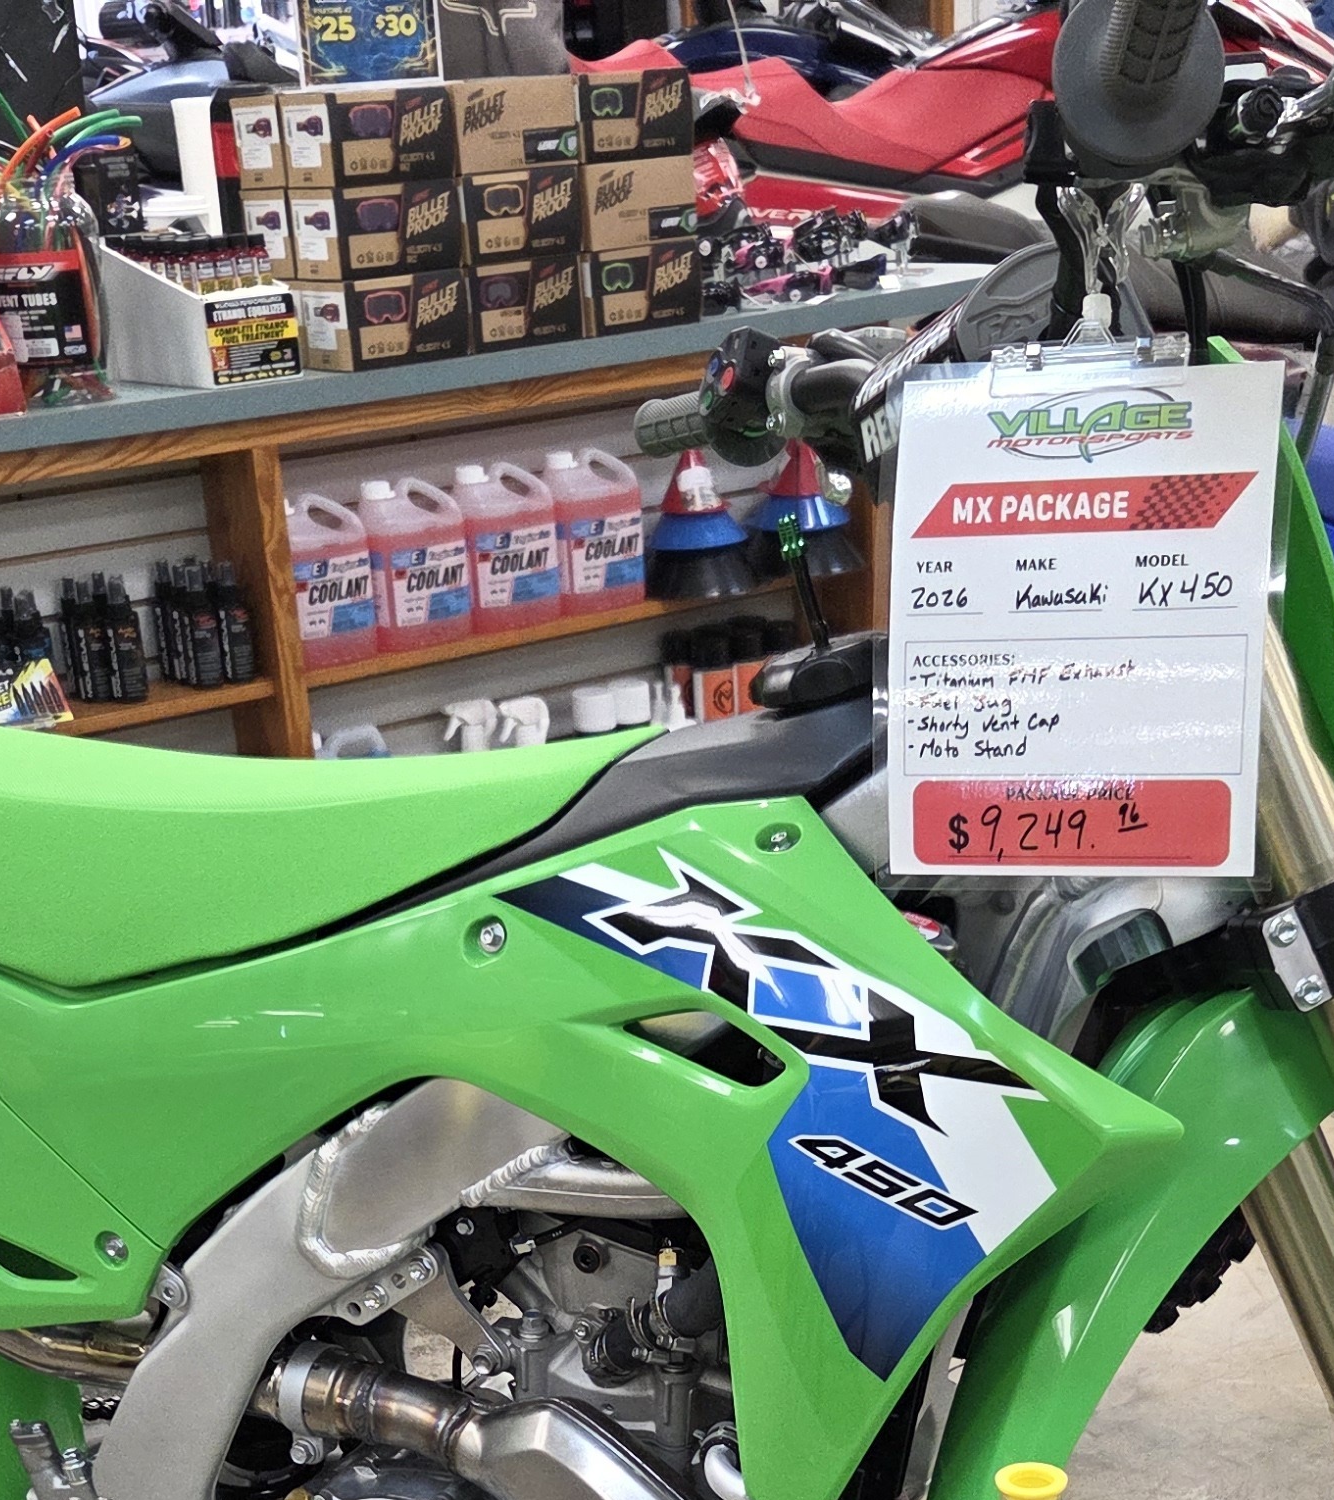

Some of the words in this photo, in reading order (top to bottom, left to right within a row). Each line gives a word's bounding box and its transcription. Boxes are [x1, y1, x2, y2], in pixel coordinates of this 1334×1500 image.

[312, 13, 356, 42] $25
[375, 13, 417, 37] $30
[987, 400, 1192, 438] VILLAGE
[987, 430, 1194, 449] MOTORSPORTS
[952, 496, 994, 524] MX
[1001, 491, 1130, 523] PACKAGE
[491, 546, 549, 576] COOLANT
[584, 533, 640, 562] COOLANT
[406, 563, 465, 594] COOLANT
[916, 560, 953, 574] YEAR
[1015, 558, 1057, 572] MAKE
[1135, 553, 1189, 568] MODEL
[308, 576, 369, 606] COOLANT
[911, 586, 968, 610] 2026
[1016, 583, 1109, 608] Kawasaki
[1140, 576, 1174, 608] KX
[1180, 572, 1234, 600] 450
[913, 652, 1015, 668] ACCESSORIES:
[974, 736, 1028, 757] Stand
[787, 1134, 979, 1230] 450
